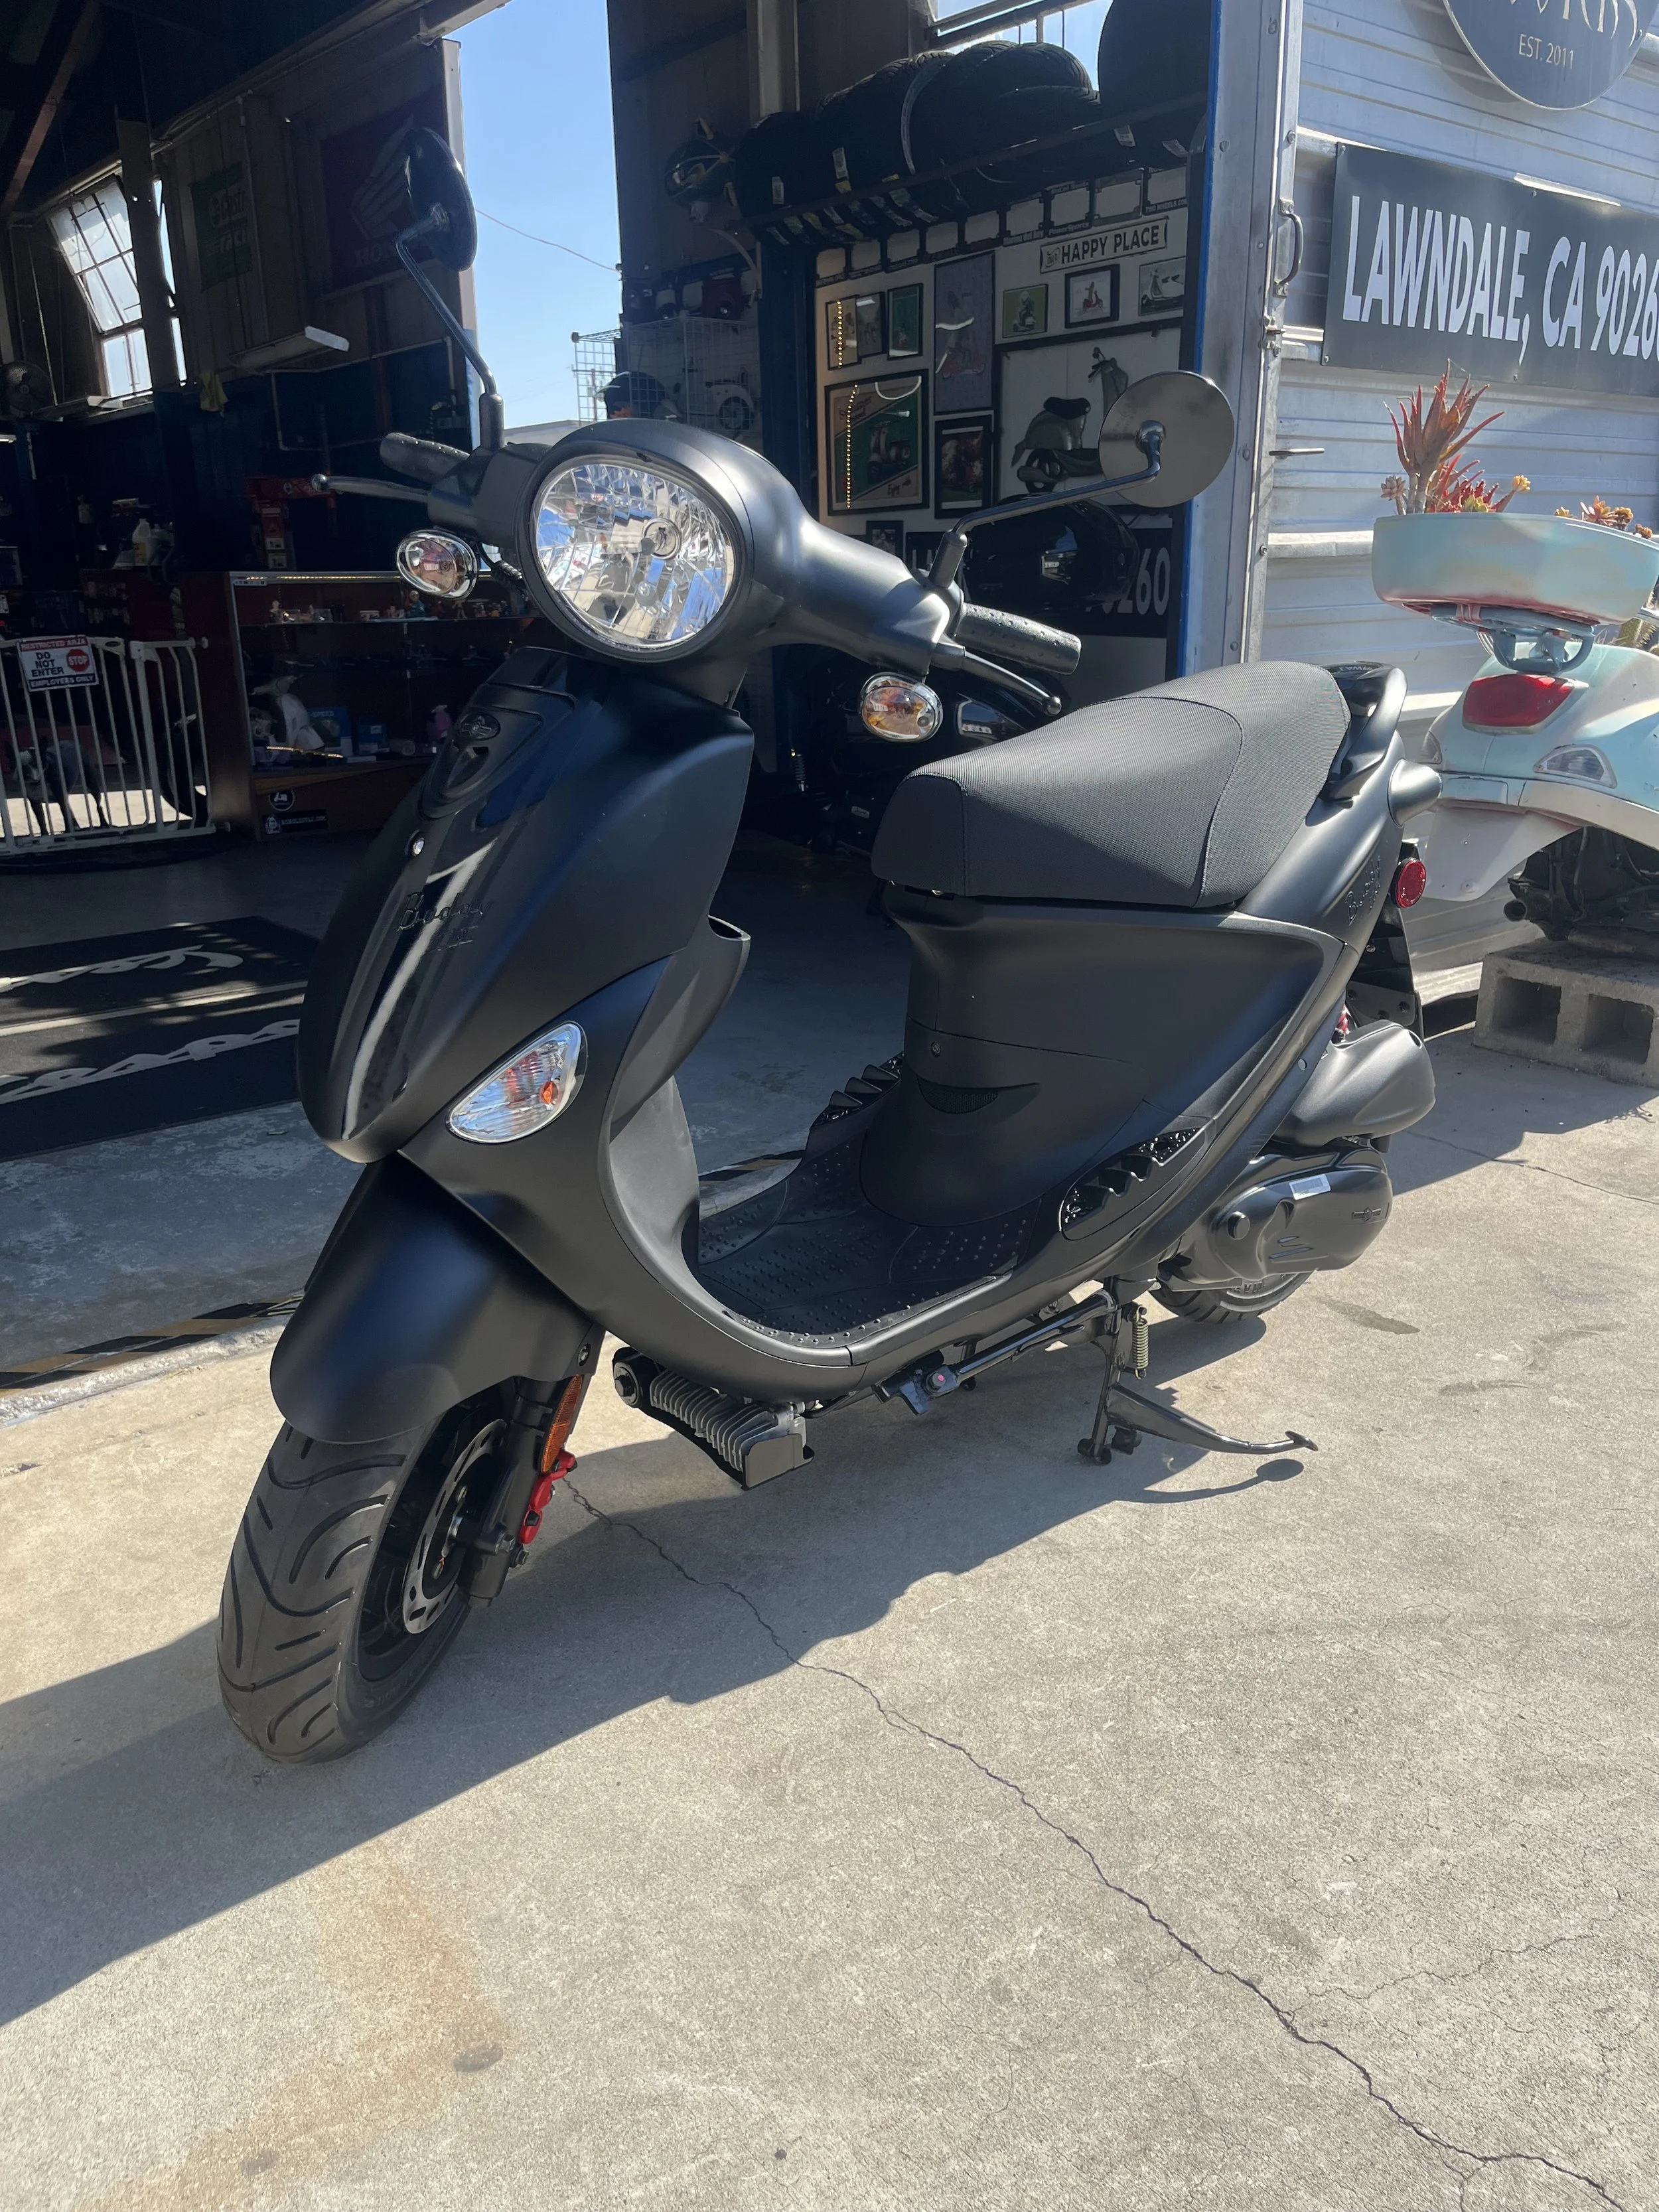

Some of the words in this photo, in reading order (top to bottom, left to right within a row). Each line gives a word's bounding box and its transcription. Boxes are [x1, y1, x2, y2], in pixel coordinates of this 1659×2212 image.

[1518, 34, 1542, 61] EST.
[1546, 42, 1573, 69] 2011
[1062, 236, 1108, 264] HAPPY
[1114, 226, 1159, 253] PLACE
[1342, 196, 1530, 366] LAWNDALE,
[1543, 236, 1587, 349] CA
[1591, 246, 1659, 362] 9026
[21, 640, 65, 650] RESTRICTED
[35, 659, 55, 668] NOT
[68, 655, 88, 666] STOP
[31, 666, 64, 677] ENTER
[31, 677, 75, 688] EMPLOYEES
